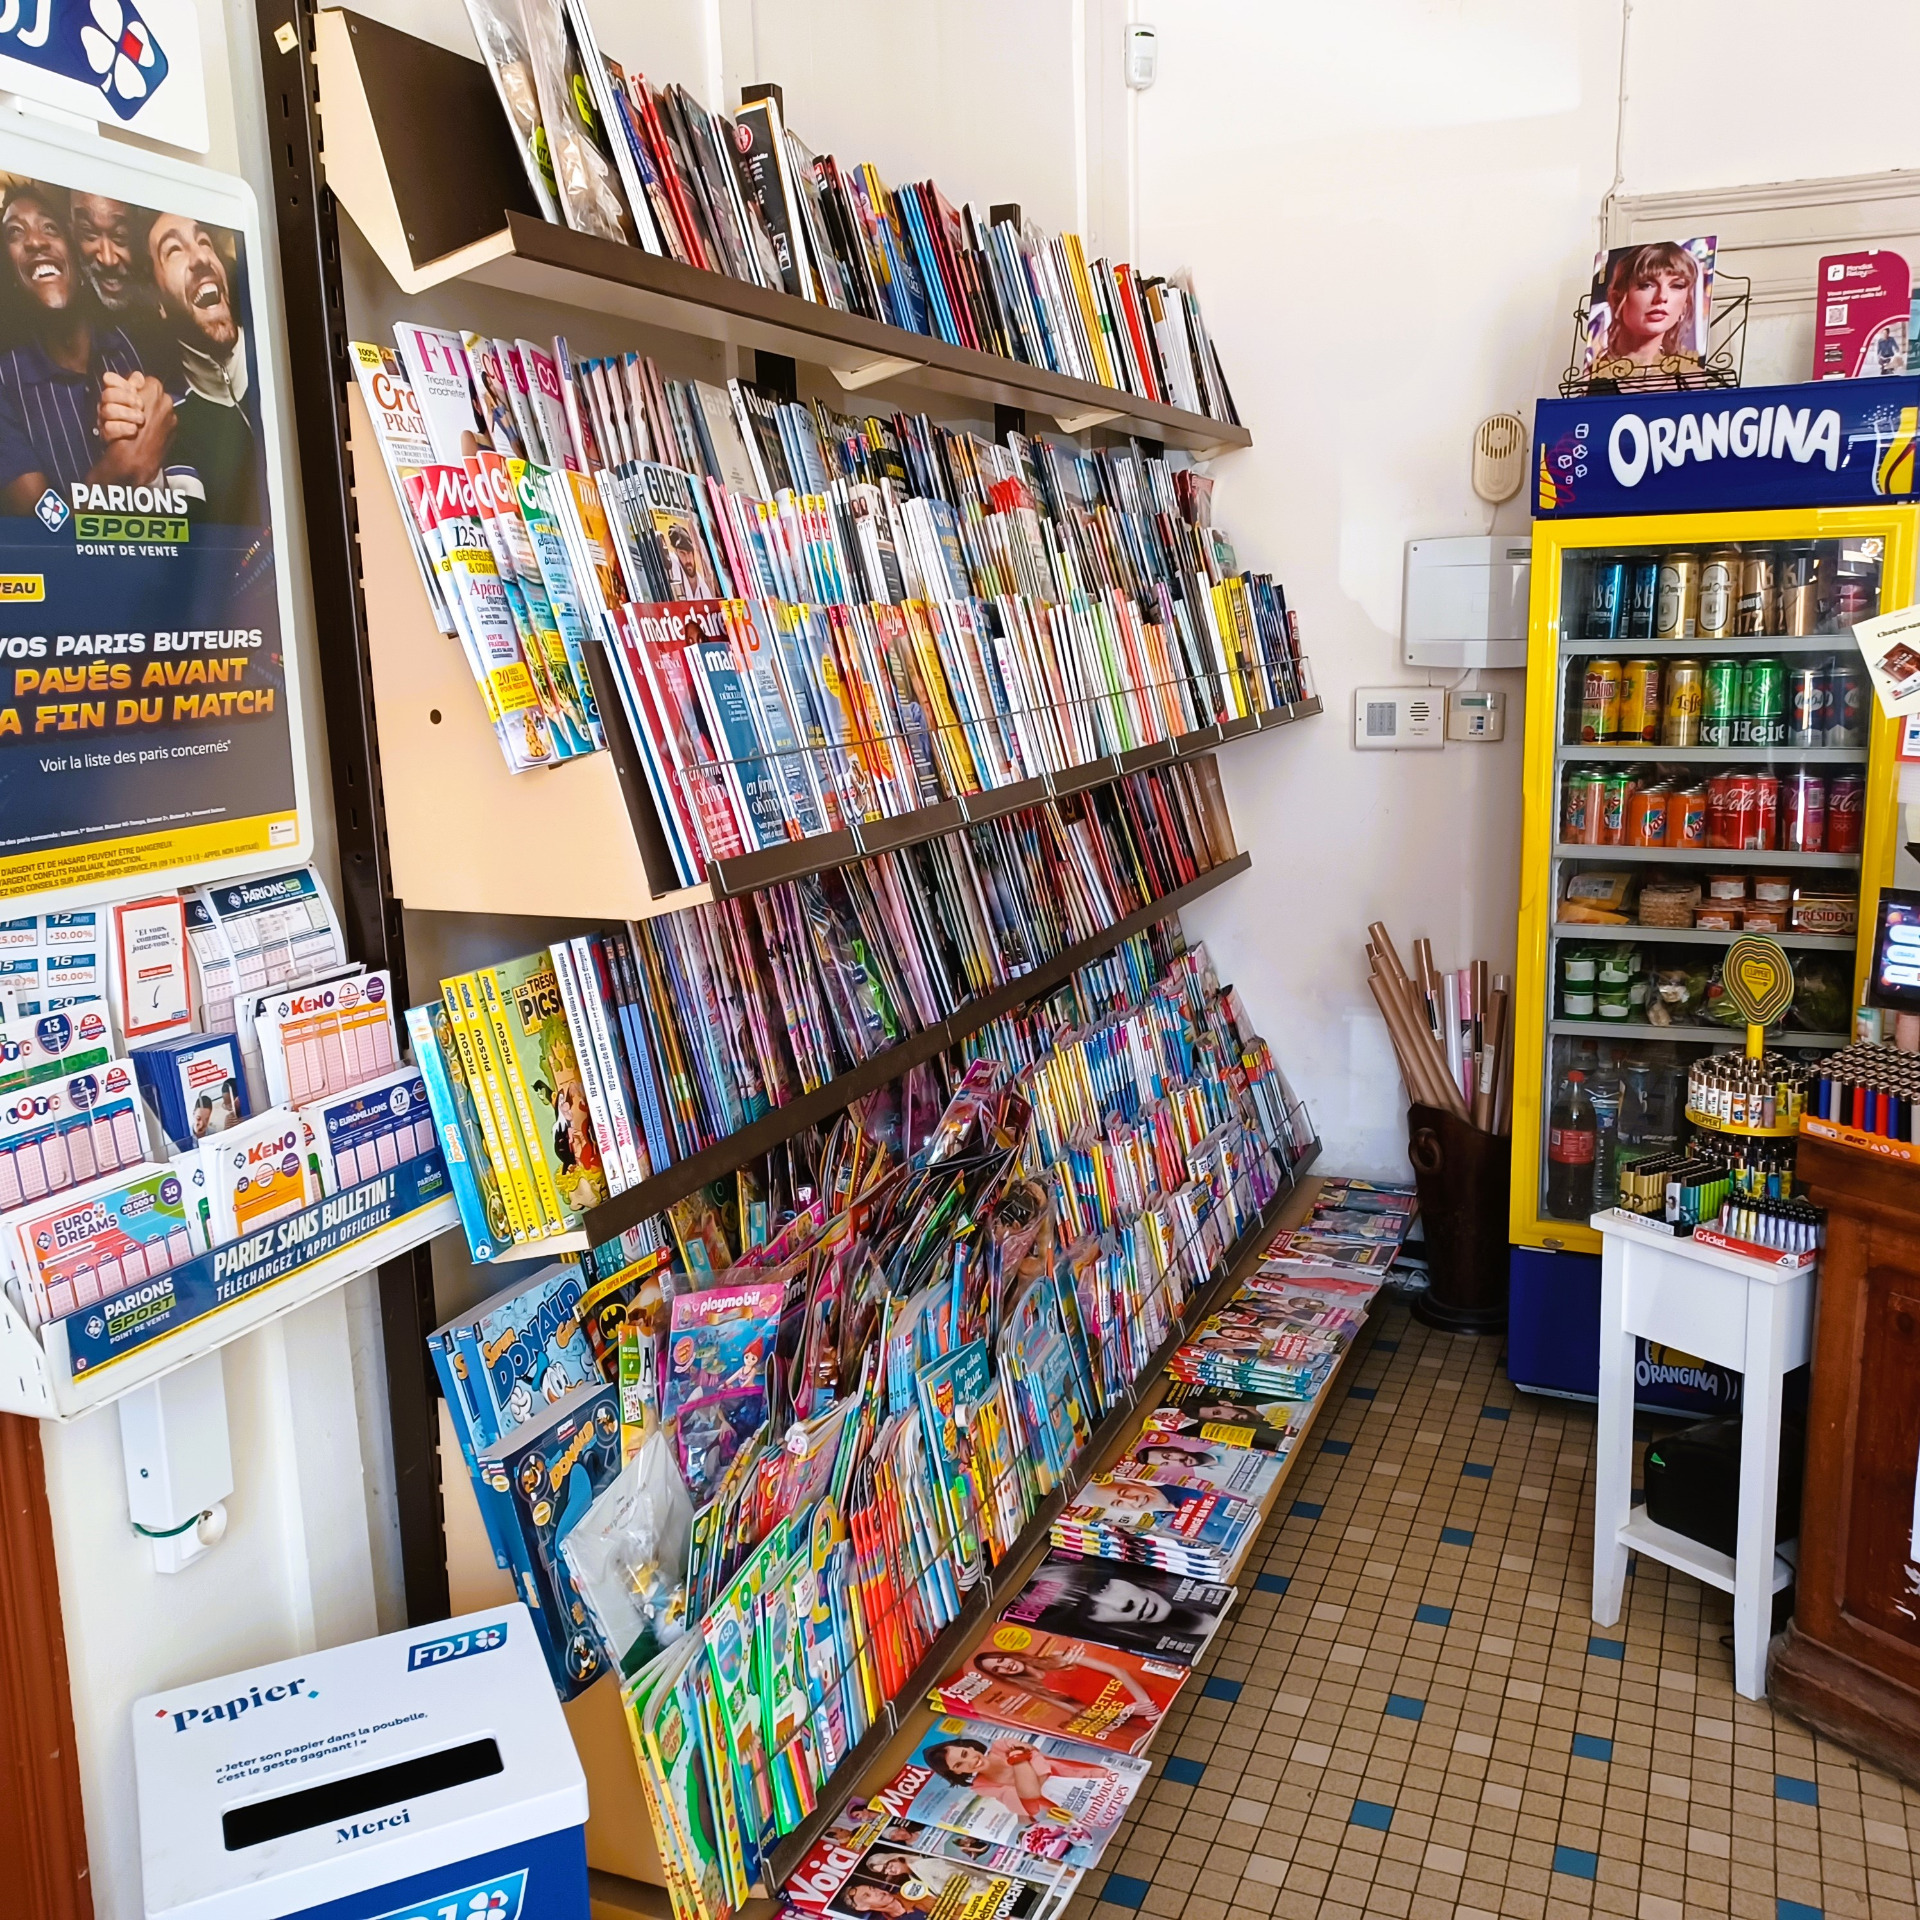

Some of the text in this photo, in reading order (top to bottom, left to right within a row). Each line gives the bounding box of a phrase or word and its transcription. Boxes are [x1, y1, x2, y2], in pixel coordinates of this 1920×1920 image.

[357, 347, 378, 358] 100%
[372, 372, 421, 415] Cro
[424, 374, 454, 387] Tricoter
[428, 386, 466, 399] crocheter
[382, 411, 428, 435] PRAT
[1607, 403, 1842, 488] ORANGINA
[71, 482, 188, 514] PARIONS
[79, 517, 186, 539] SPORT
[453, 525, 478, 548] 125
[76, 544, 178, 557] POINT DE VENTE
[0, 582, 36, 593] EAU
[469, 577, 505, 600] Apéro
[639, 607, 686, 643] marie
[56, 629, 262, 656] PARIS BUTEURS
[14, 657, 248, 696] PAYÉS AVANT
[494, 669, 510, 686] 20
[35, 688, 274, 733] FIN DU MATCH
[40, 758, 67, 773] Voir
[70, 756, 82, 769] la
[85, 752, 110, 768] liste
[114, 749, 136, 764] des
[139, 746, 168, 764] paris
[746, 781, 758, 796] en
[1, 863, 35, 877] D'ARGENT
[37, 861, 45, 871] ET
[47, 859, 57, 868] DE
[59, 855, 86, 867] HASARD
[87, 850, 117, 861] PEUVENT
[135, 841, 172, 855] DANGEREUX
[10, 885, 24, 895] NOS
[26, 879, 59, 892] CONSEILS
[60, 876, 74, 886] SUR
[33, 868, 68, 881] CONFLITS
[240, 881, 286, 904] PARIONS
[52, 913, 72, 924] 12
[1796, 908, 1855, 922] PRÉSIDENT
[52, 955, 72, 966] 16
[1746, 966, 1770, 979] CLIPPER
[514, 972, 556, 999] LES TRÉSO
[84, 1016, 97, 1025] 50
[518, 988, 561, 1026] PICS
[44, 1018, 60, 1032] 13
[585, 1066, 596, 1087] pages
[393, 1092, 404, 1104] 17
[459, 1033, 506, 1173] LES DE PICSOU
[474, 1029, 521, 1170] LES DE PICSOU
[495, 1022, 542, 1162] LES DE PICSOU
[6, 1096, 61, 1124] LOTO
[338, 1102, 388, 1127] EUROMILLIONS
[1695, 1111, 1720, 1128] CLIPPER
[248, 1131, 297, 1165] KENO
[164, 1185, 178, 1197] 30
[417, 1171, 442, 1187] PARIONS
[122, 1197, 149, 1214] 20 000
[504, 1184, 518, 1225] DISNEY
[517, 1181, 532, 1222] DISNEY
[538, 1174, 554, 1215] DISNEY
[53, 1209, 93, 1235] EURO
[56, 1213, 118, 1248] DREAMS
[212, 1173, 396, 1282] PARIEZ SANS BULLETIN !
[1695, 1230, 1727, 1246] Cricket
[216, 1206, 391, 1302] TÉLÉCHARGEZ L'APPLI OFFICIELLE
[103, 1277, 174, 1320] PARIONS
[699, 1291, 761, 1317] playmobil
[108, 1293, 174, 1335] SPORT
[109, 1311, 171, 1345] POINT DE VENTE
[489, 1277, 583, 1411] DONALD
[1635, 1359, 1718, 1393] ORANGINA
[549, 1420, 595, 1493] DONALD
[728, 1526, 787, 1624] TOUPIE
[719, 1622, 734, 1643] 150
[414, 1633, 469, 1668] FDJ
[171, 1677, 306, 1733] Papier
[1066, 1677, 1124, 1734] NOS RECETTES
[225, 1712, 428, 1772] Jeter son papier dans la poubelle,
[217, 1741, 352, 1784] c'est le geste gagnant
[877, 1765, 932, 1817] Maxi
[1079, 1769, 1120, 1830] framboises
[1103, 1784, 1130, 1824] cerises
[335, 1808, 411, 1844] Merci
[787, 1843, 860, 1908] Voici
[963, 1895, 984, 1918] Luana
[976, 1880, 1008, 1920] elmondo
